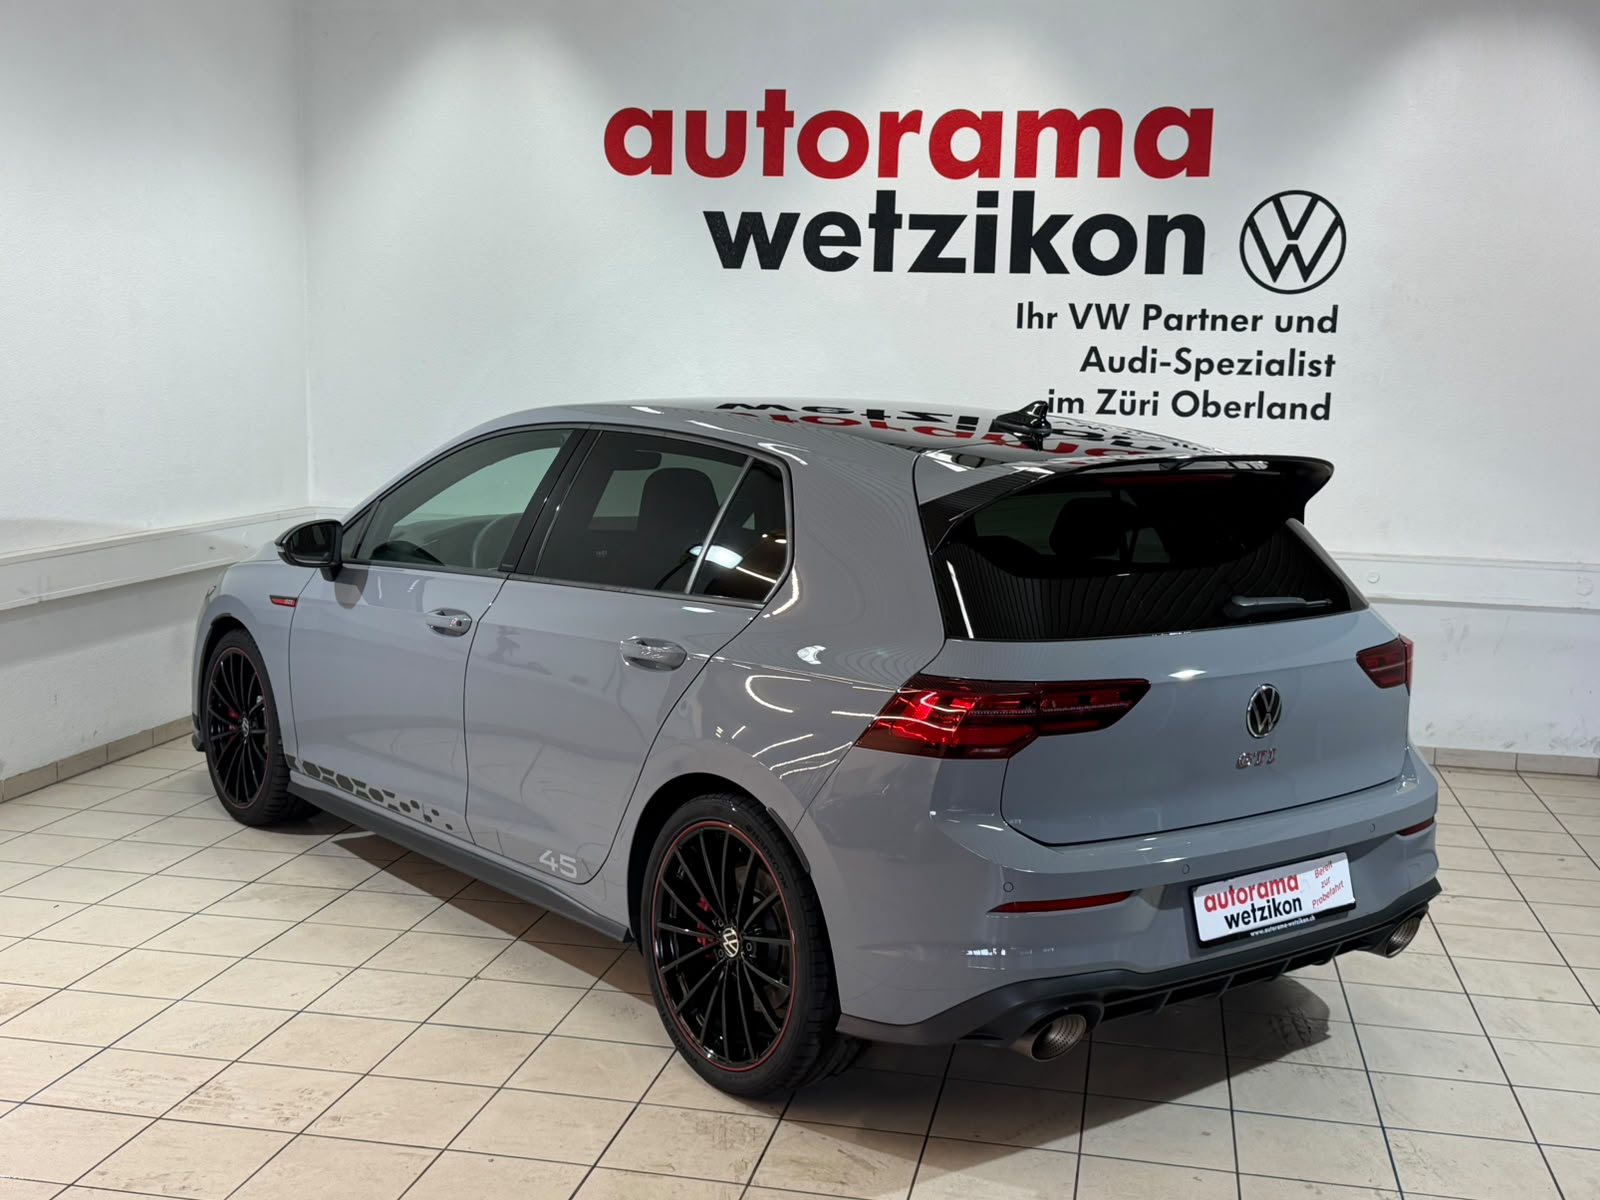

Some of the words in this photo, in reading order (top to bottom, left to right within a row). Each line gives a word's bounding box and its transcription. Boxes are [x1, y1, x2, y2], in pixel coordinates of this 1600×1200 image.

[603, 88, 1214, 180] autorama
[702, 189, 1206, 277] wetzikon
[1016, 301, 1058, 329] Ihr
[1068, 302, 1131, 330] VW
[1142, 303, 1264, 333] Partner
[1275, 304, 1339, 334] und
[1079, 345, 1336, 382] Audi-Spezialist
[1047, 388, 1085, 415] im
[1095, 388, 1159, 417] Züri
[1171, 390, 1332, 421] Oberland
[1236, 748, 1277, 770] GTI
[539, 849, 578, 879] 45
[1314, 860, 1333, 879] Bereit
[1203, 873, 1300, 913] autorama
[1311, 879, 1344, 910] Probefahrt
[1320, 876, 1331, 889] zur
[1224, 897, 1303, 930] wetzikon
